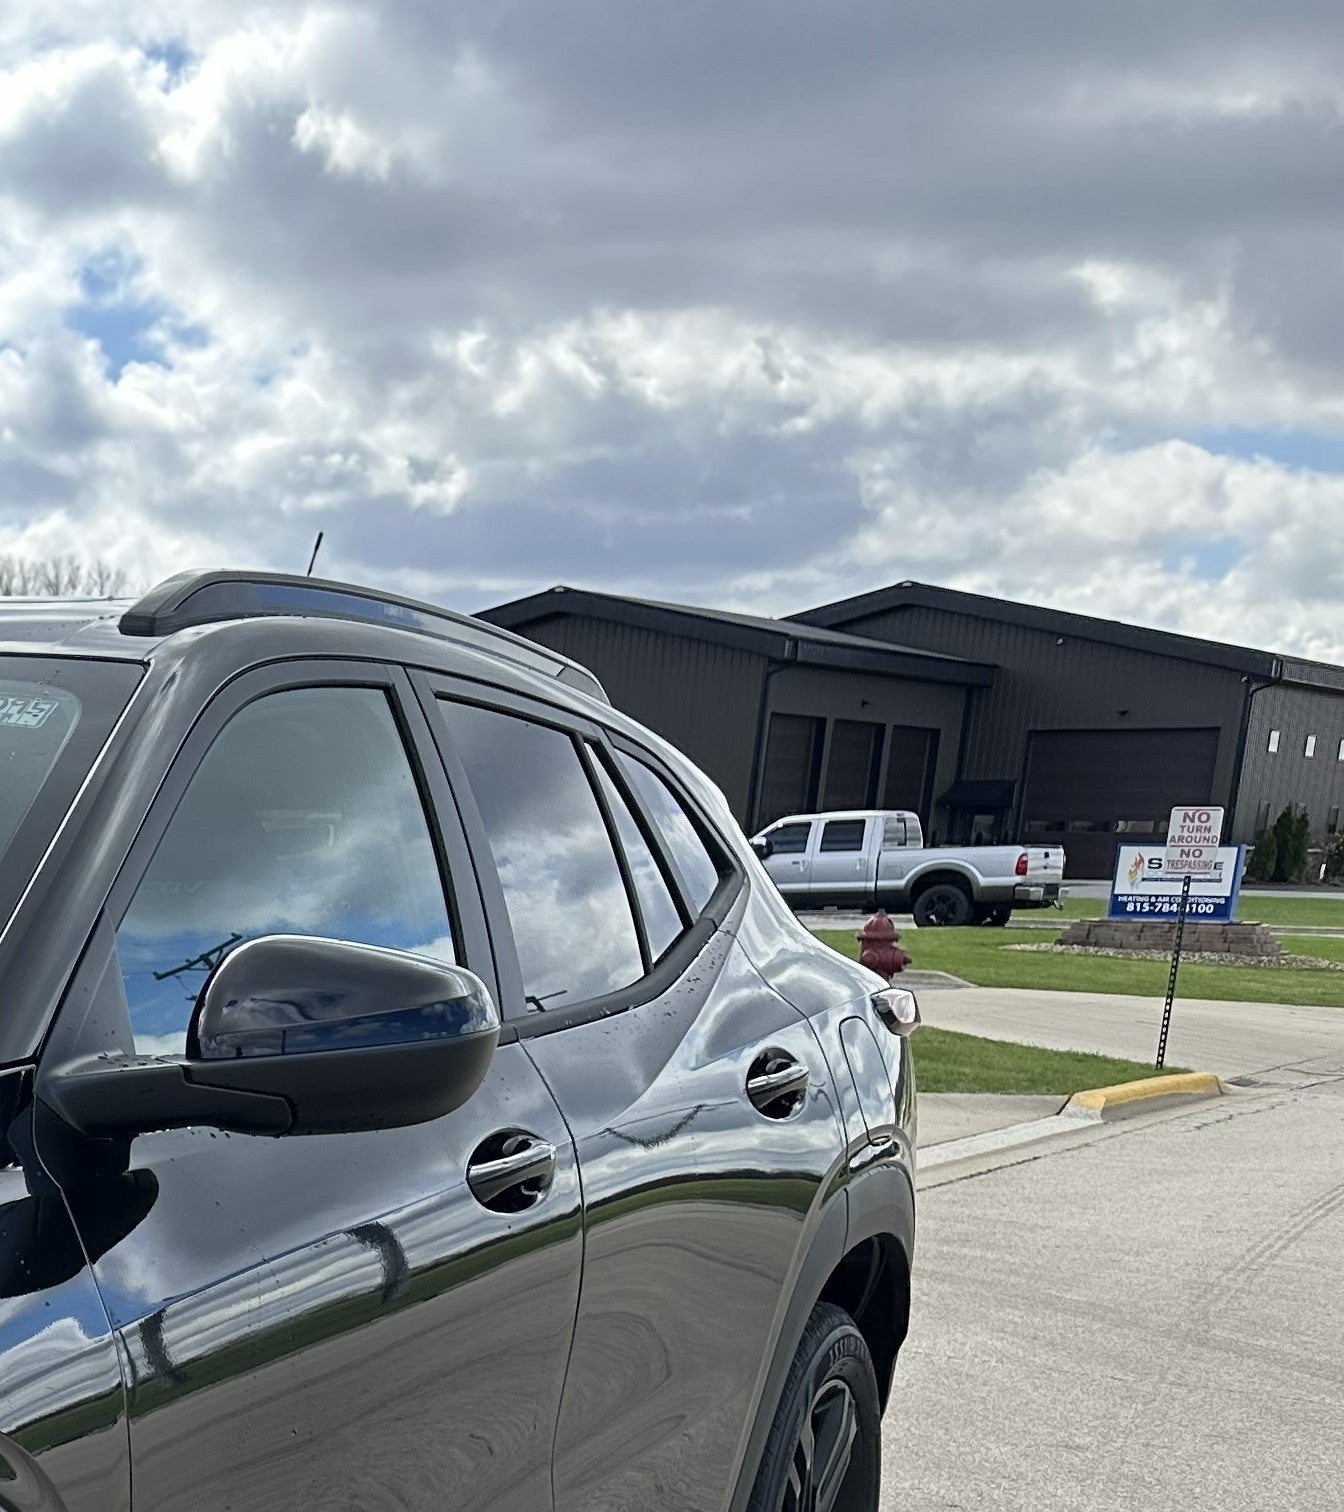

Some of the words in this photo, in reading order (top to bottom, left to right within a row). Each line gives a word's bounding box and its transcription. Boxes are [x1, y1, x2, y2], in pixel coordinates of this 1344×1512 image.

[1182, 811, 1211, 824] NO
[1179, 825, 1212, 834] TURN
[1168, 835, 1219, 845] AROUND
[1179, 848, 1203, 859] NO
